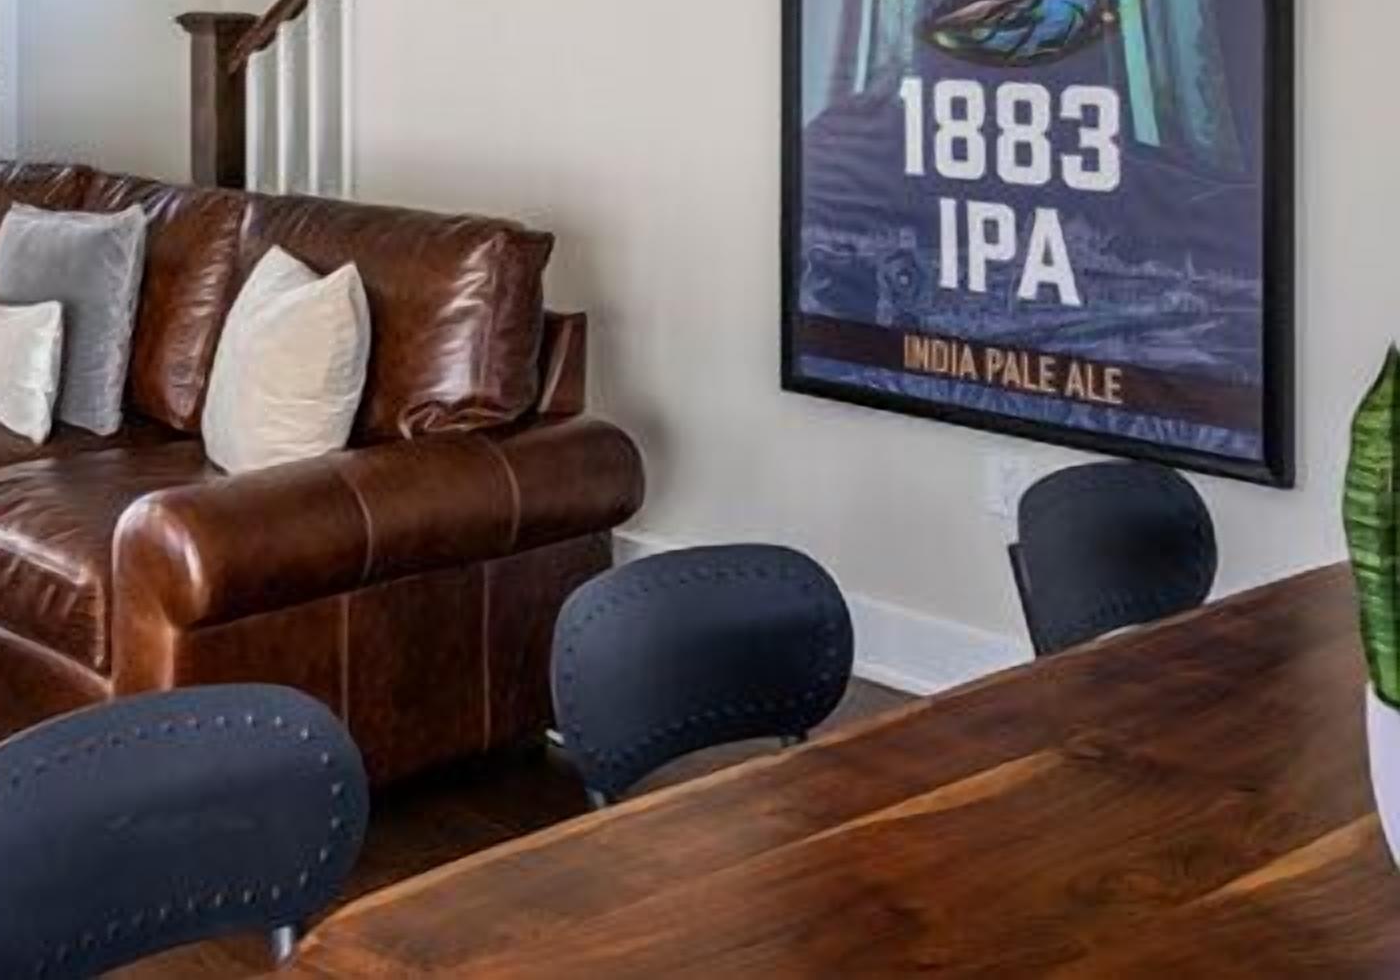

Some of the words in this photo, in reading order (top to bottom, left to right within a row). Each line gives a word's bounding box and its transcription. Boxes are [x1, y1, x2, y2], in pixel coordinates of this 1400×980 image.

[900, 78, 1121, 192] 1883
[939, 198, 1080, 307] IPA
[904, 335, 976, 380] INDIA
[985, 348, 1057, 393] PALE
[1064, 365, 1123, 404] ALE
